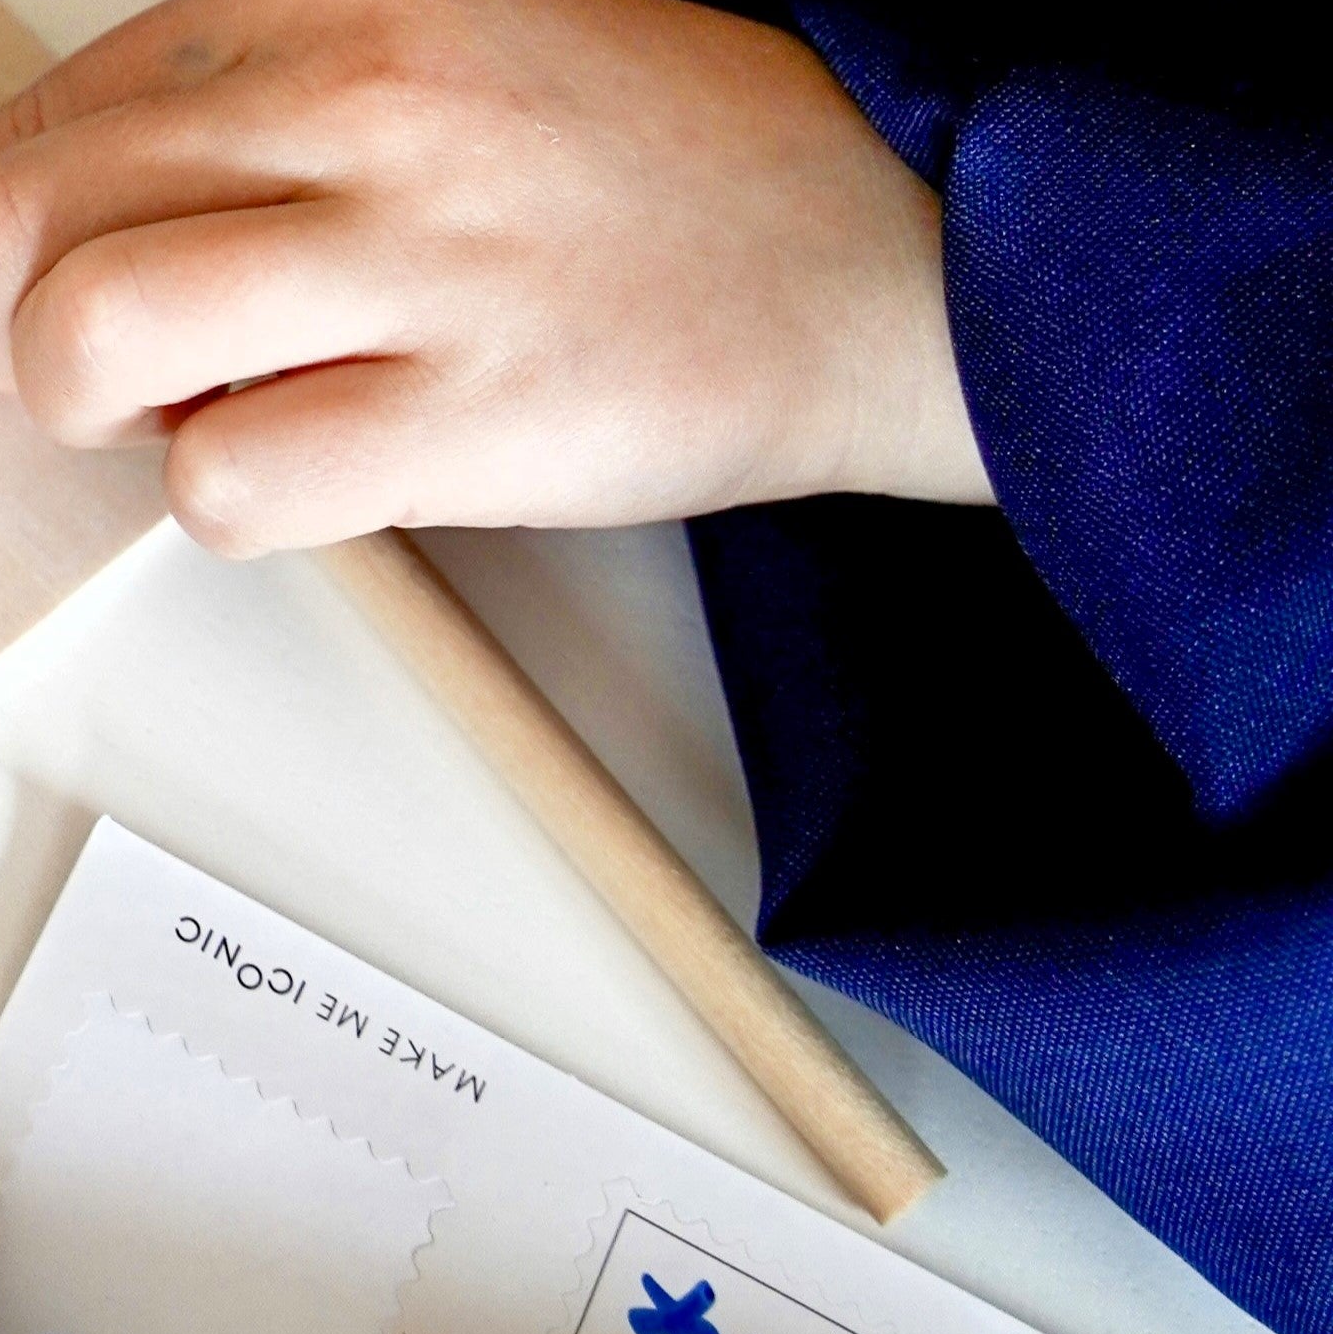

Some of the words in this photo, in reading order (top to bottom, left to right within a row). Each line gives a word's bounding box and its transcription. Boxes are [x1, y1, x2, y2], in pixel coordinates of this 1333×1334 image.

[175, 916, 306, 1004] ICONIC
[316, 993, 369, 1038] ME
[379, 1027, 486, 1103] MAKE
